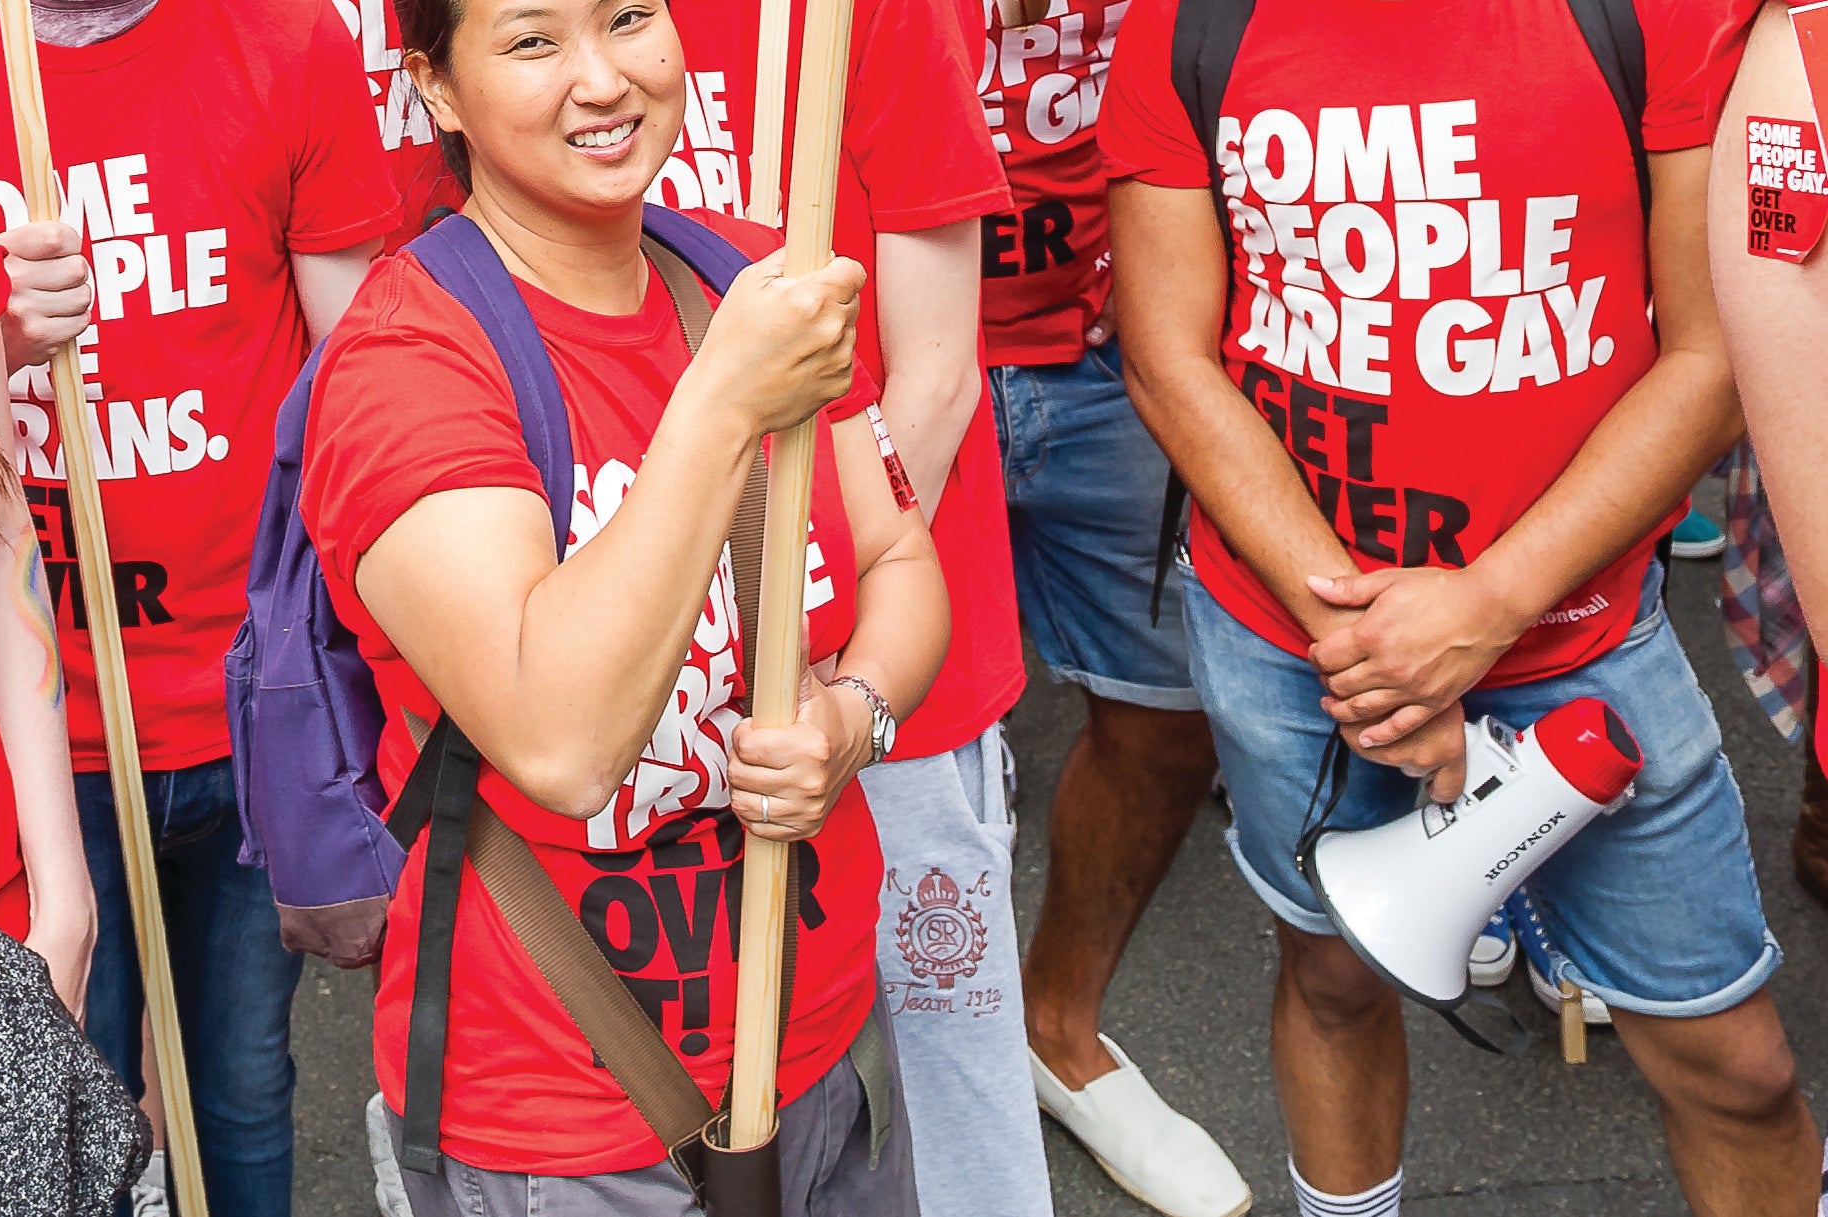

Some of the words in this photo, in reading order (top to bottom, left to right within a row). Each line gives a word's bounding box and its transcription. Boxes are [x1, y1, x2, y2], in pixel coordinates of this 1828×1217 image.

[1748, 121, 1802, 148] SOME
[1216, 99, 1481, 203] SOME
[1748, 143, 1816, 172] PEOPLE
[1749, 164, 1784, 190] ARE
[1787, 169, 1828, 196] GAY.
[1751, 187, 1782, 209] GET
[1751, 209, 1797, 234] OVER
[1226, 195, 1579, 300] PEOPLE
[1750, 230, 1770, 251] IT!
[1239, 276, 1392, 397] ARE
[1414, 275, 1614, 397] GAY.
[1241, 362, 1388, 483] GET
[1484, 811, 1567, 880] MONACOR
[887, 867, 912, 895] R
[884, 982, 956, 1015] Team
